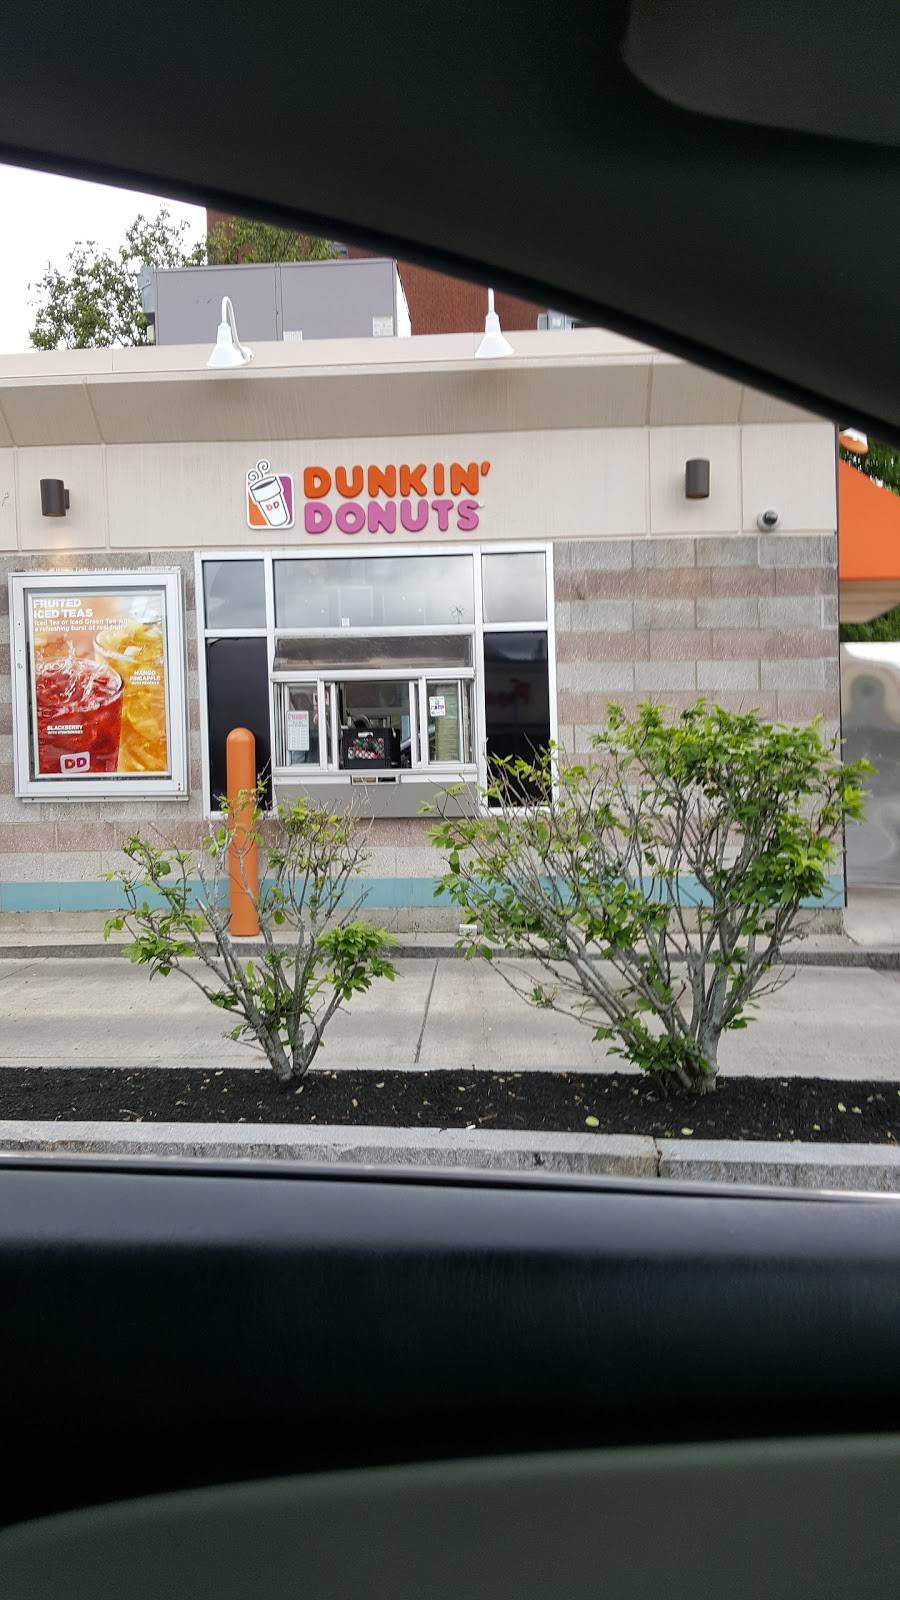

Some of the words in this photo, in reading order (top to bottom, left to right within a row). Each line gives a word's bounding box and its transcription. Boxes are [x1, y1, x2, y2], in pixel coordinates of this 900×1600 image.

[303, 461, 491, 499] DUNKIN'
[304, 499, 480, 534] DONUTS
[33, 599, 81, 608] FRUITED
[33, 609, 60, 618] ICED
[62, 608, 94, 618] TEAS
